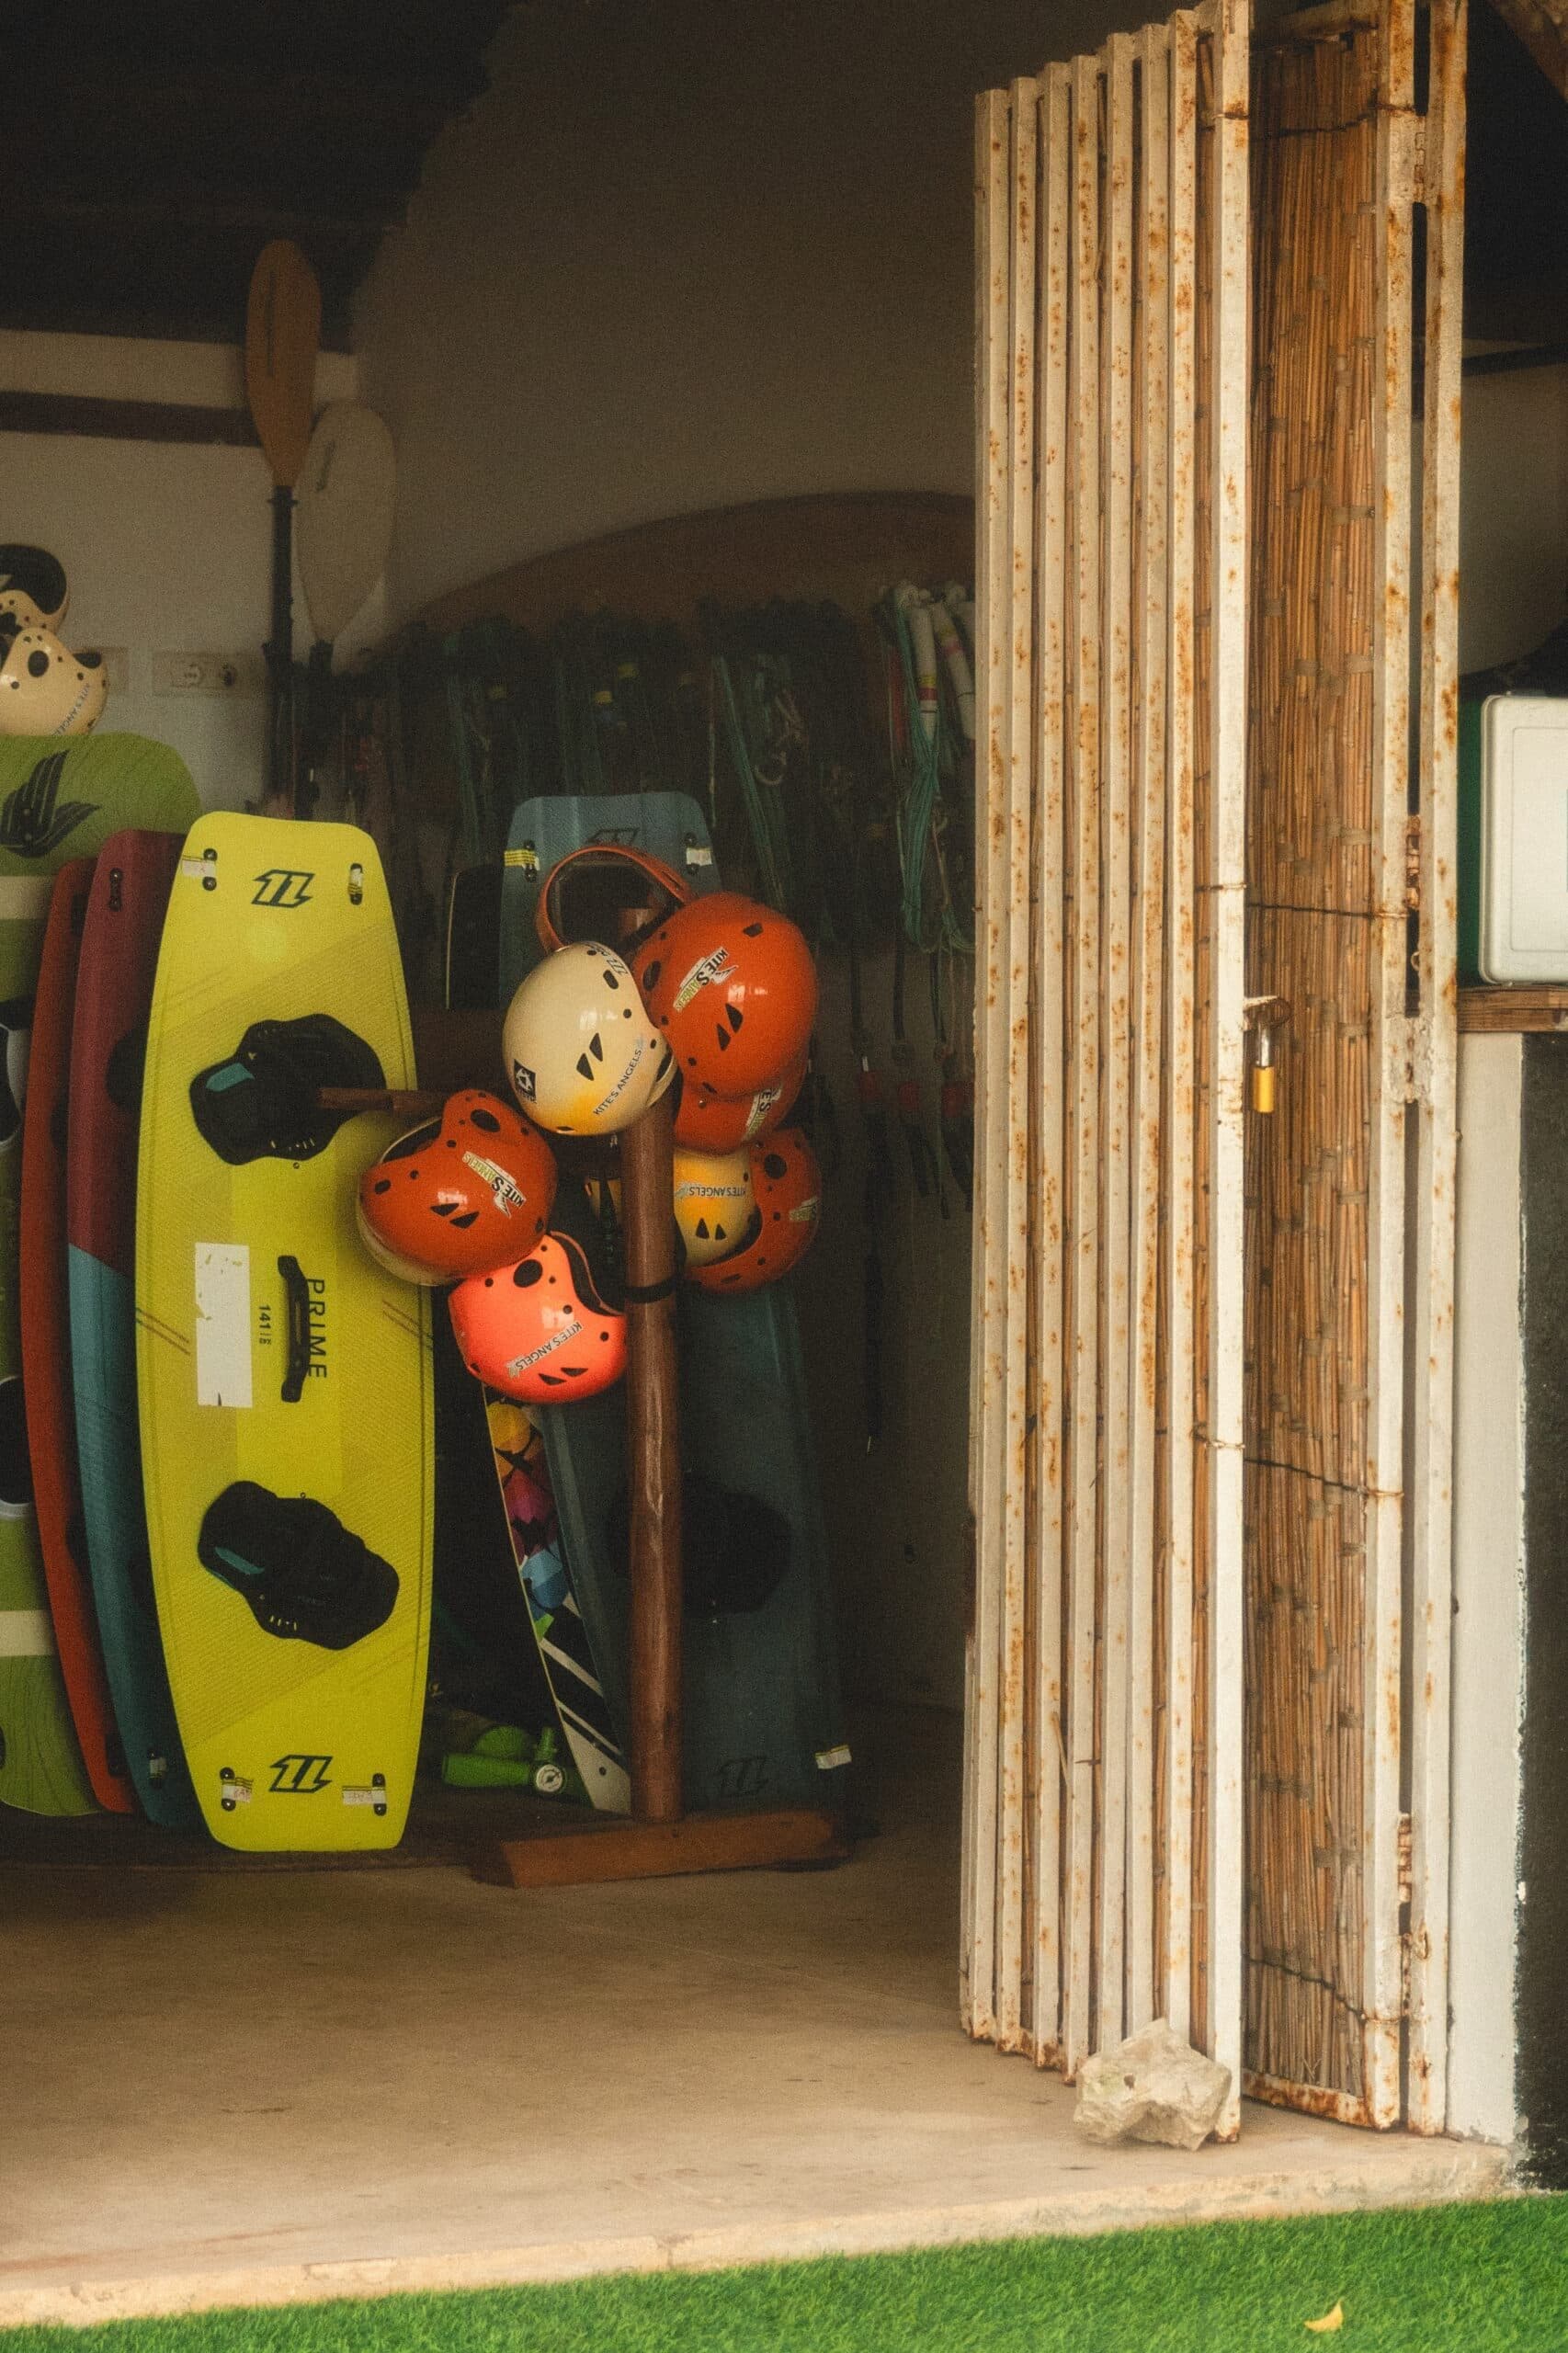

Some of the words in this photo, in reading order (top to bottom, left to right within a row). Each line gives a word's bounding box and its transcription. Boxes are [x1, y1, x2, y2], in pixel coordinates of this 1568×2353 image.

[614, 1048, 643, 1091] ANGELS
[688, 1185, 725, 1198] ANGELS
[259, 1304, 271, 1329] 141
[307, 1279, 327, 1378] PRIME
[515, 1341, 554, 1372] ANGELS
